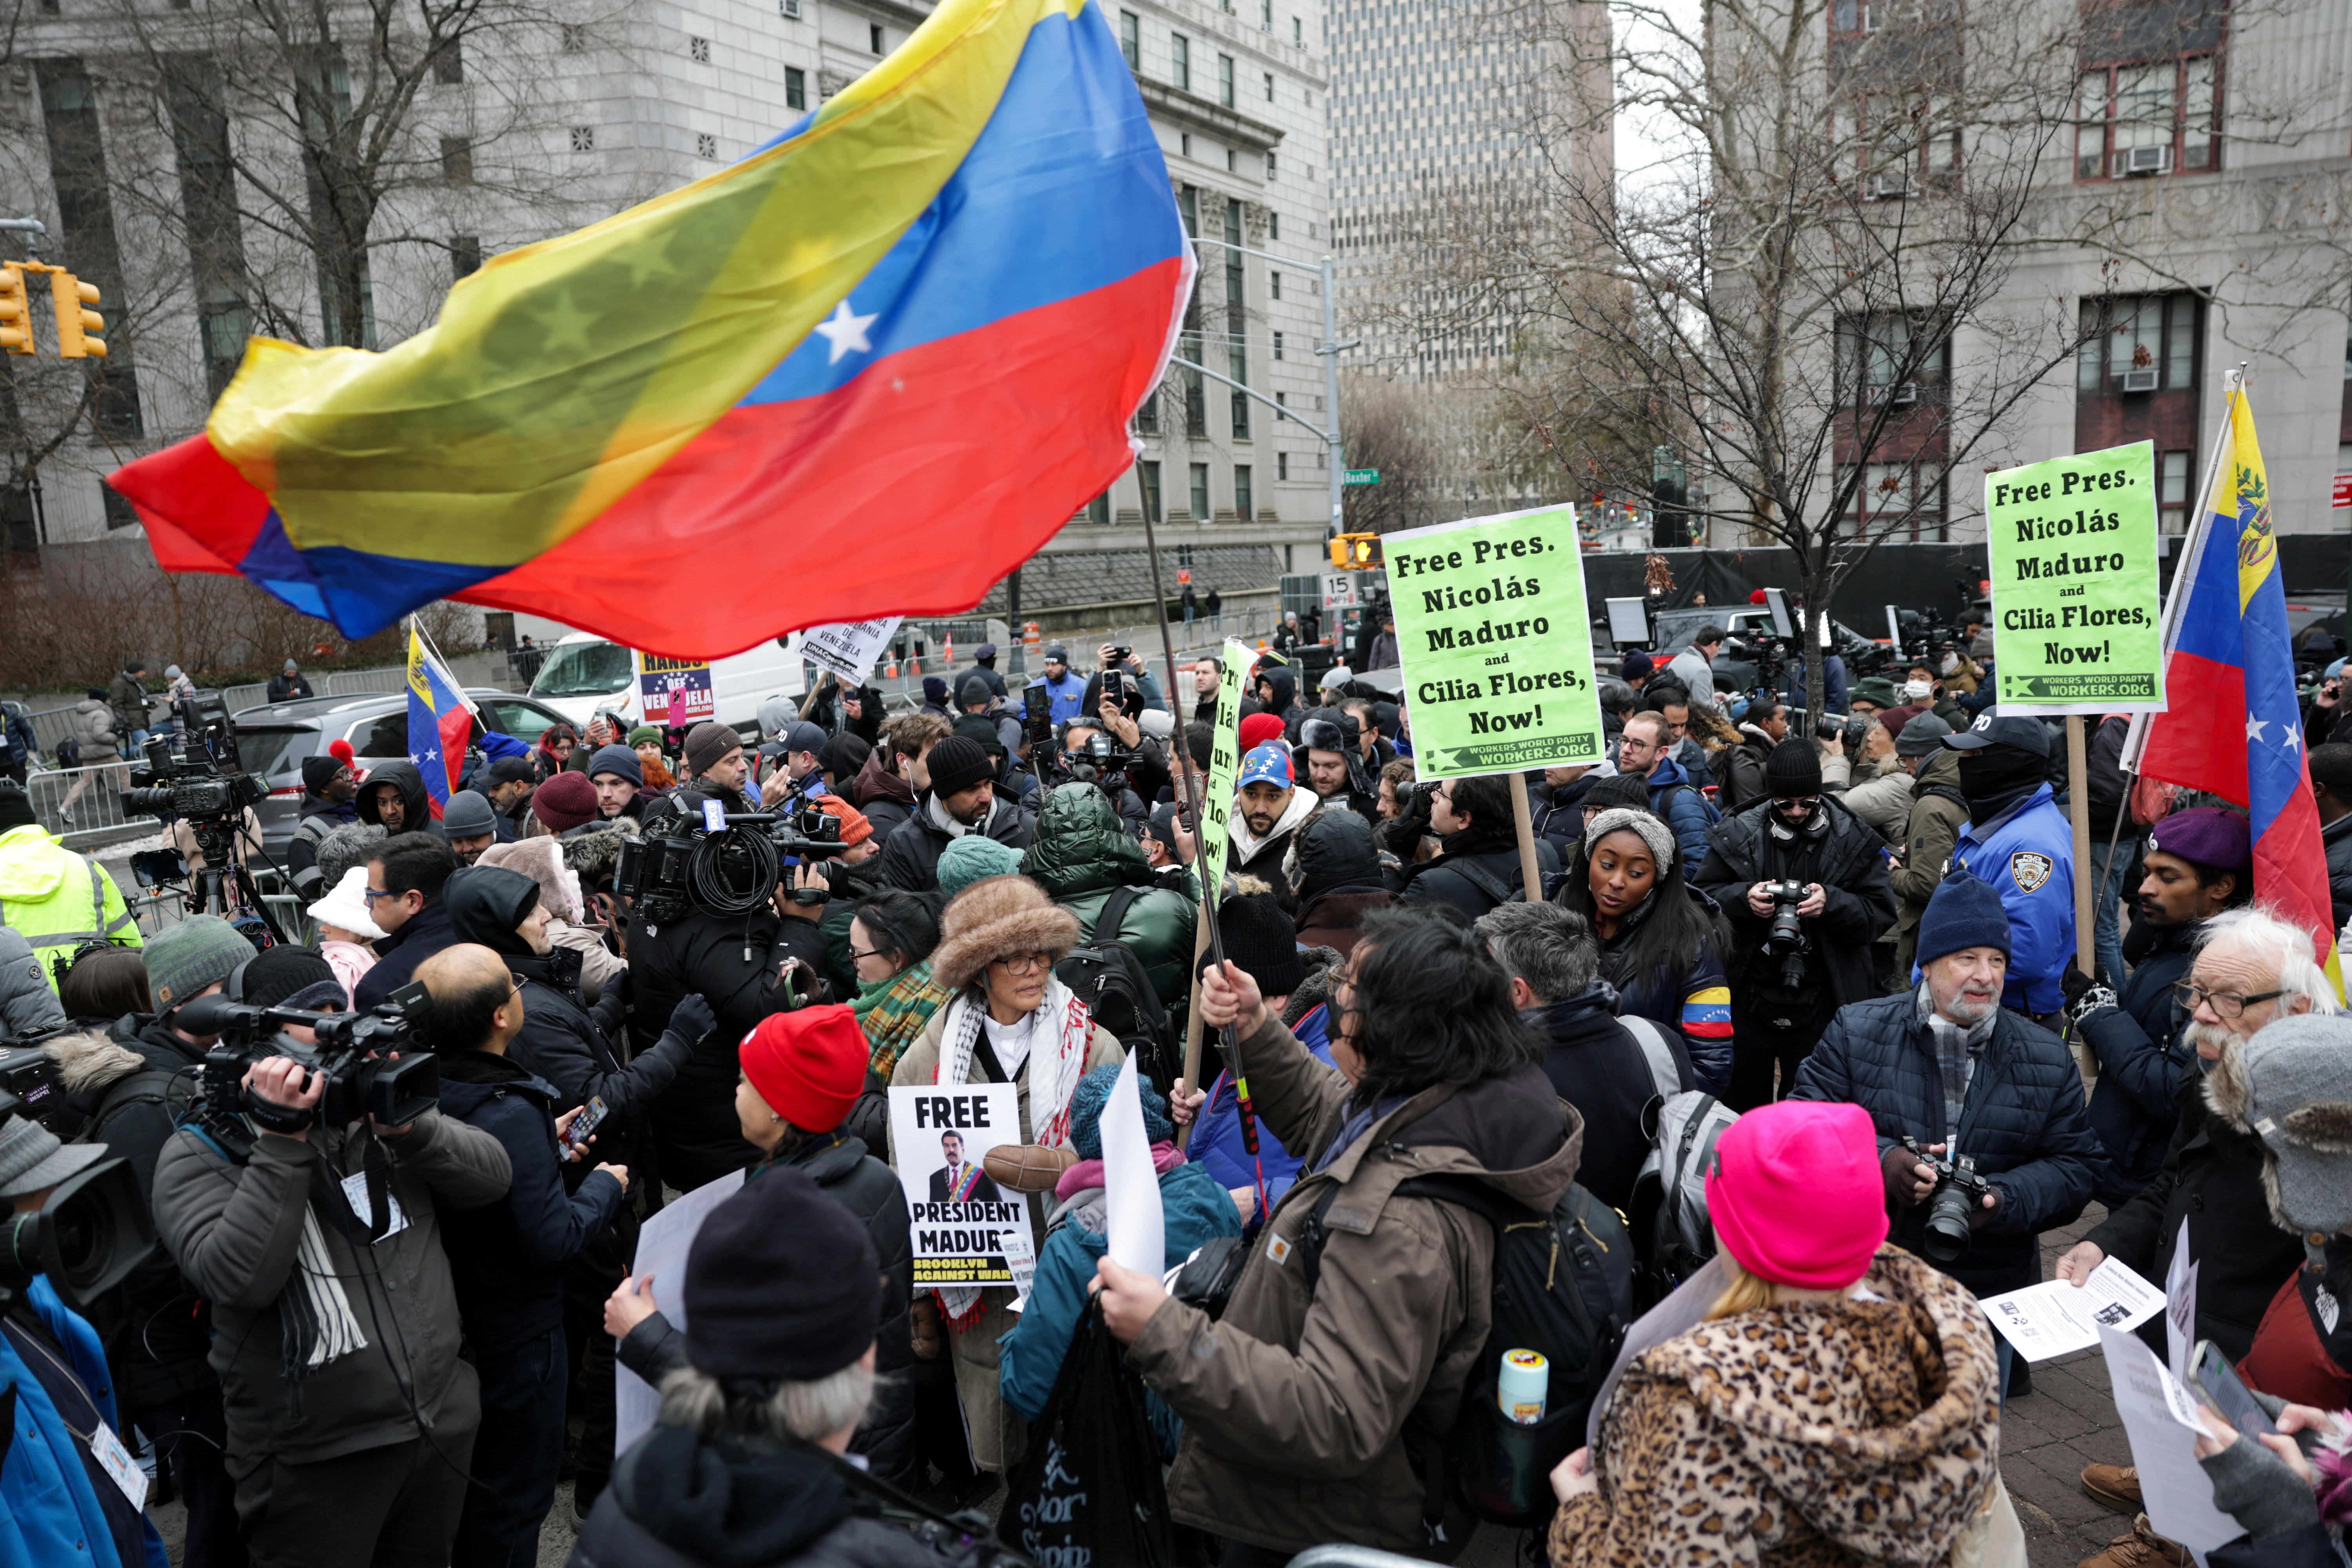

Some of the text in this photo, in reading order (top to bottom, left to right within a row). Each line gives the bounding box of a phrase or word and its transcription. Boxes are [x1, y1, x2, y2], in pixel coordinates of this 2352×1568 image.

[1345, 472, 1371, 483] Baxter
[1996, 470, 2134, 506] Free Pres.
[2016, 509, 2119, 542] Nicolás
[1395, 536, 1554, 578] Free Pres.
[2016, 552, 2124, 580] Maduro
[1329, 577, 1348, 593] 15
[1422, 575, 1540, 613] Nicolás
[2060, 585, 2085, 597] and
[1331, 595, 1349, 604] MPH
[2004, 605, 2151, 630] Cilia Flores,
[820, 630, 860, 657] VENEZUELA
[842, 628, 854, 639] DE
[1426, 617, 1549, 652] Maduro
[1485, 653, 1510, 666] and
[2044, 640, 2109, 664] Now!
[1418, 670, 1586, 704] Cilia Flores,
[2049, 684, 2150, 696] WORKERS.ORG
[1469, 704, 1543, 734] Now!
[1469, 735, 1589, 755] WORKERS WORLD PARTY
[1479, 743, 1591, 765] WORKERS.ORG
[710, 810, 720, 830] PIX
[2015, 858, 2049, 869] DEPARTMENT
[2031, 870, 2049, 889] NEW YORK
[254, 1107, 282, 1122] SONY
[915, 1096, 990, 1128] FREE
[1955, 1178, 1969, 1186] LUMIX
[913, 1202, 1020, 1222] PRESIDENT
[919, 1229, 1016, 1253] MADUR
[913, 1258, 988, 1269] BROOKLYN
[913, 1270, 975, 1280] AGAINST
[978, 1270, 1011, 1279] WAR
[2315, 1296, 2327, 1321] FACE
[2316, 1283, 2333, 1314] NORTH
[2325, 1292, 2336, 1308] THE
